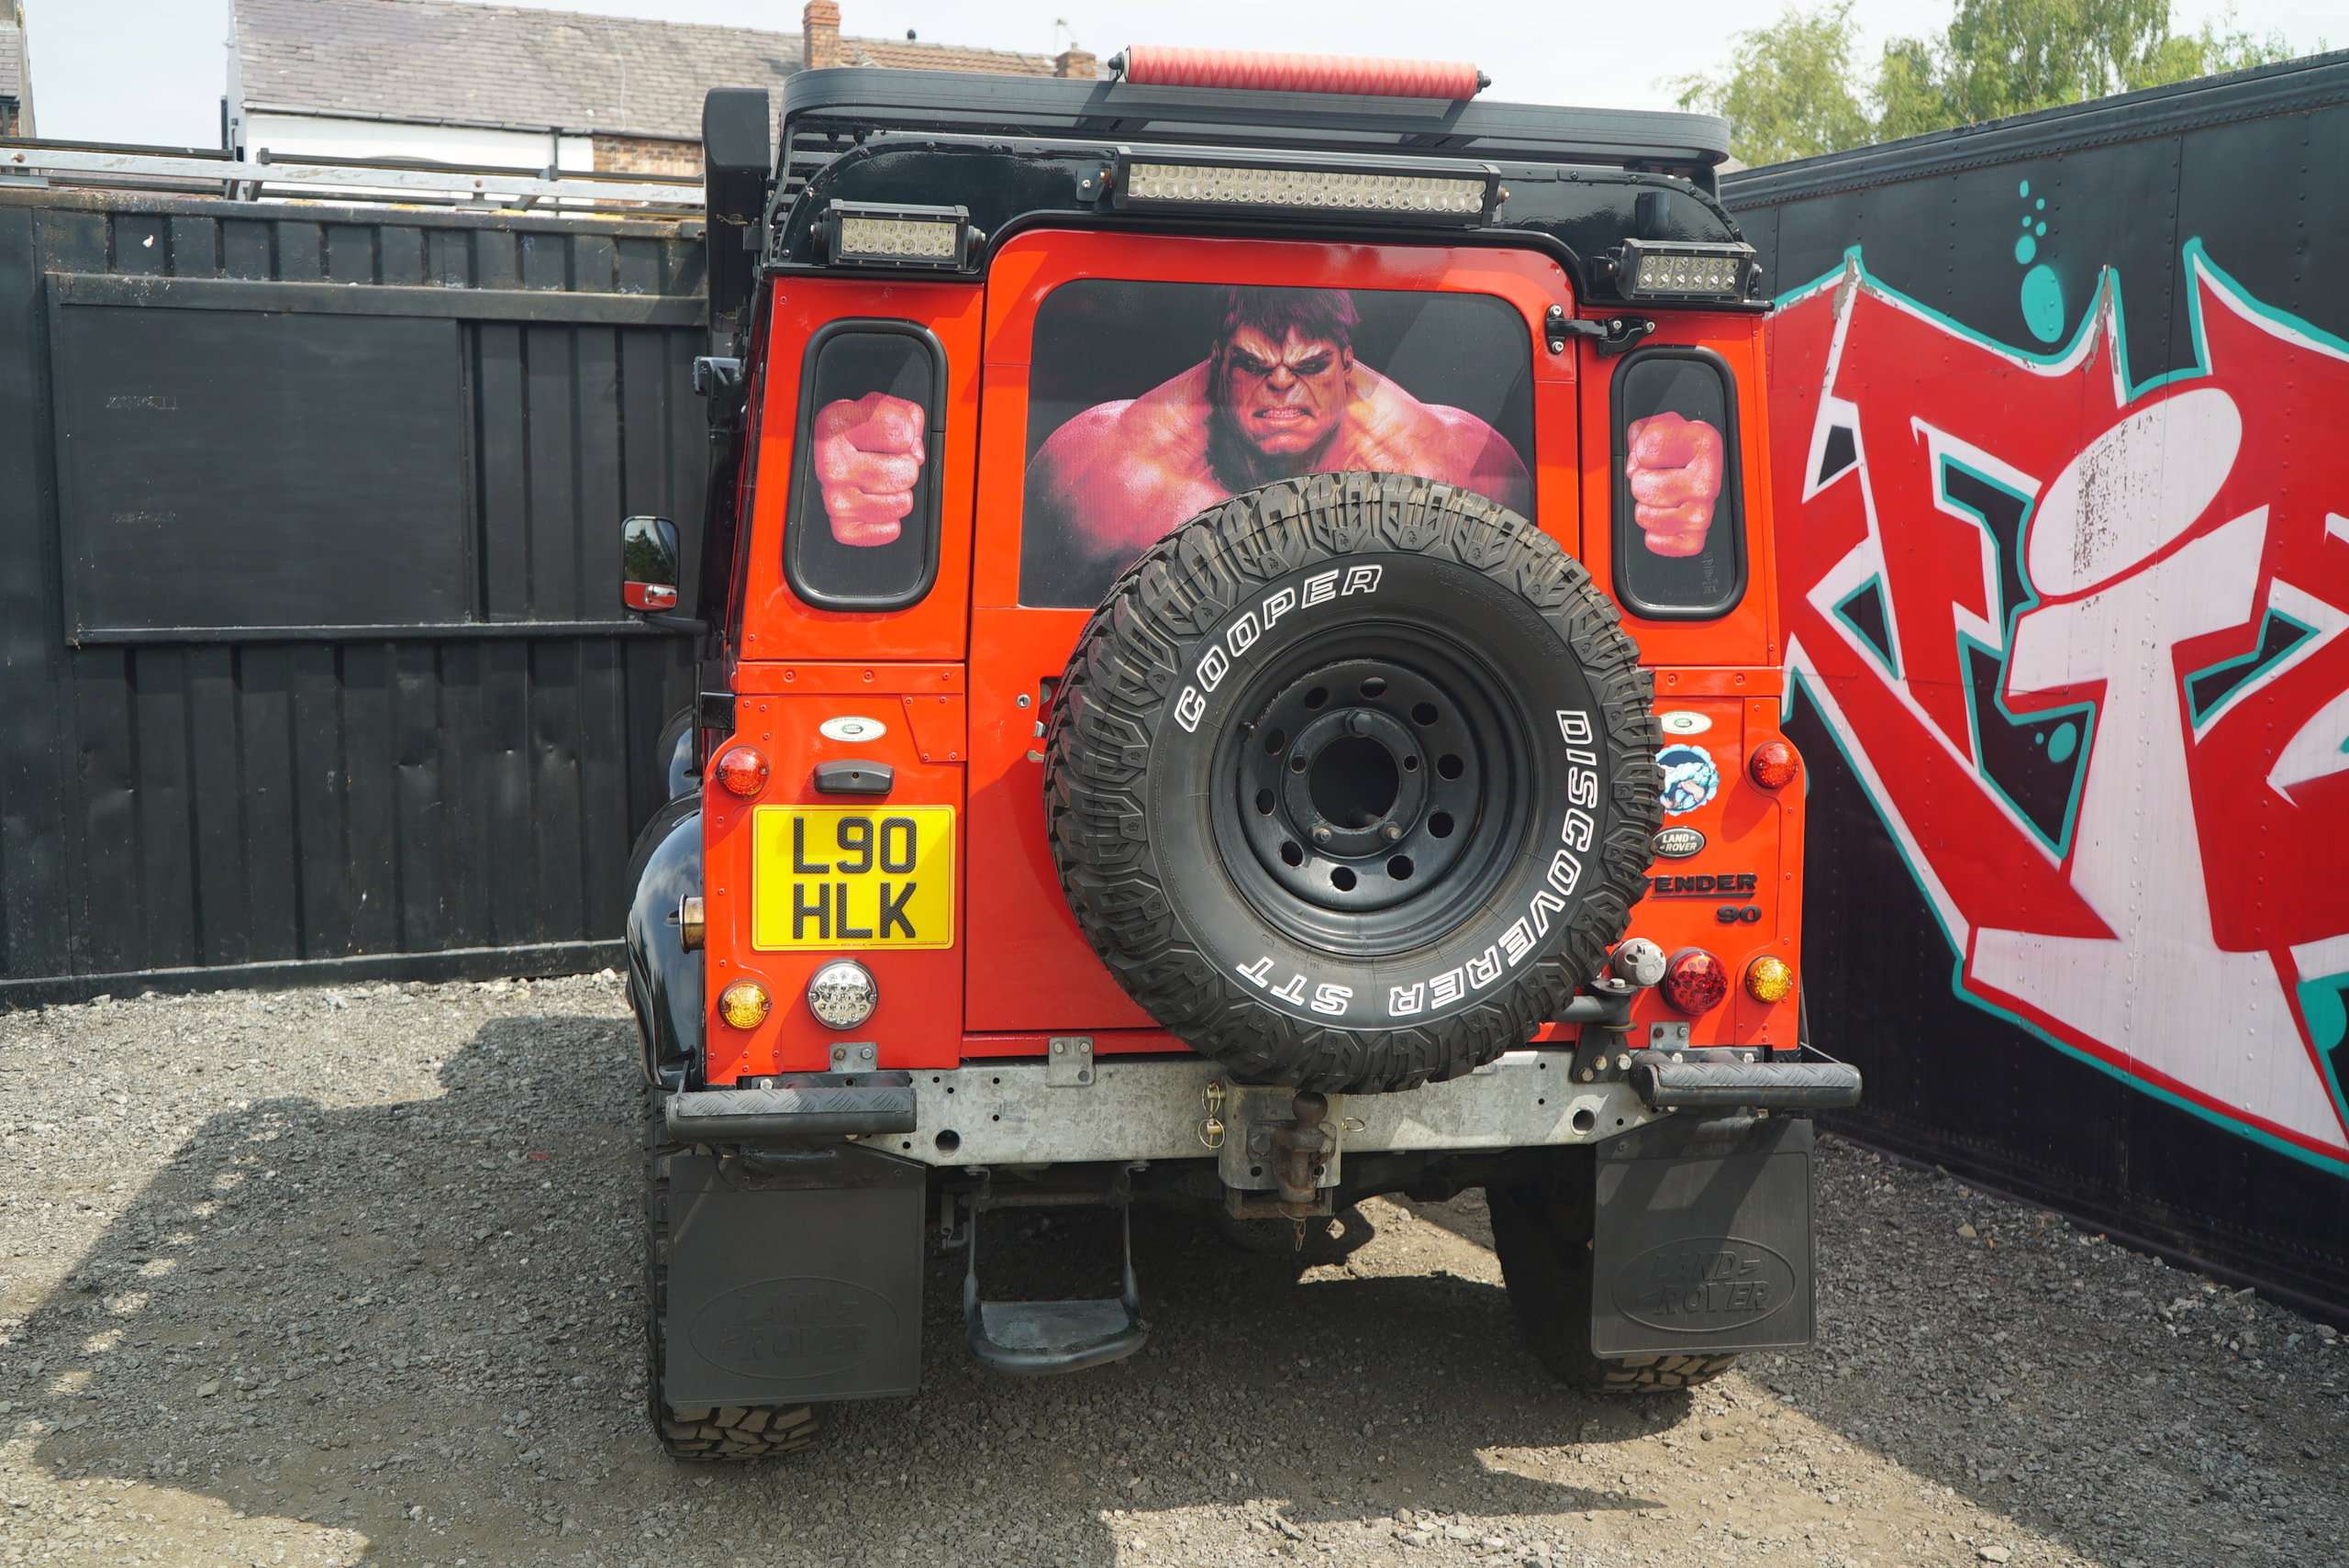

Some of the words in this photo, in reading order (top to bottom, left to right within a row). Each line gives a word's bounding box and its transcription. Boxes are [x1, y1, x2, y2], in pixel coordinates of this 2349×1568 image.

[1174, 564, 1383, 732] COOPER
[793, 817, 917, 874] L90
[1387, 709, 1599, 1018] DISCOVERER
[1663, 834, 1688, 843] LAND
[1665, 842, 1698, 852] ROVER
[793, 882, 917, 940] HLK
[1653, 873, 1757, 893] ENDER
[1717, 905, 1762, 924] 90
[1237, 954, 1353, 1017] STT
